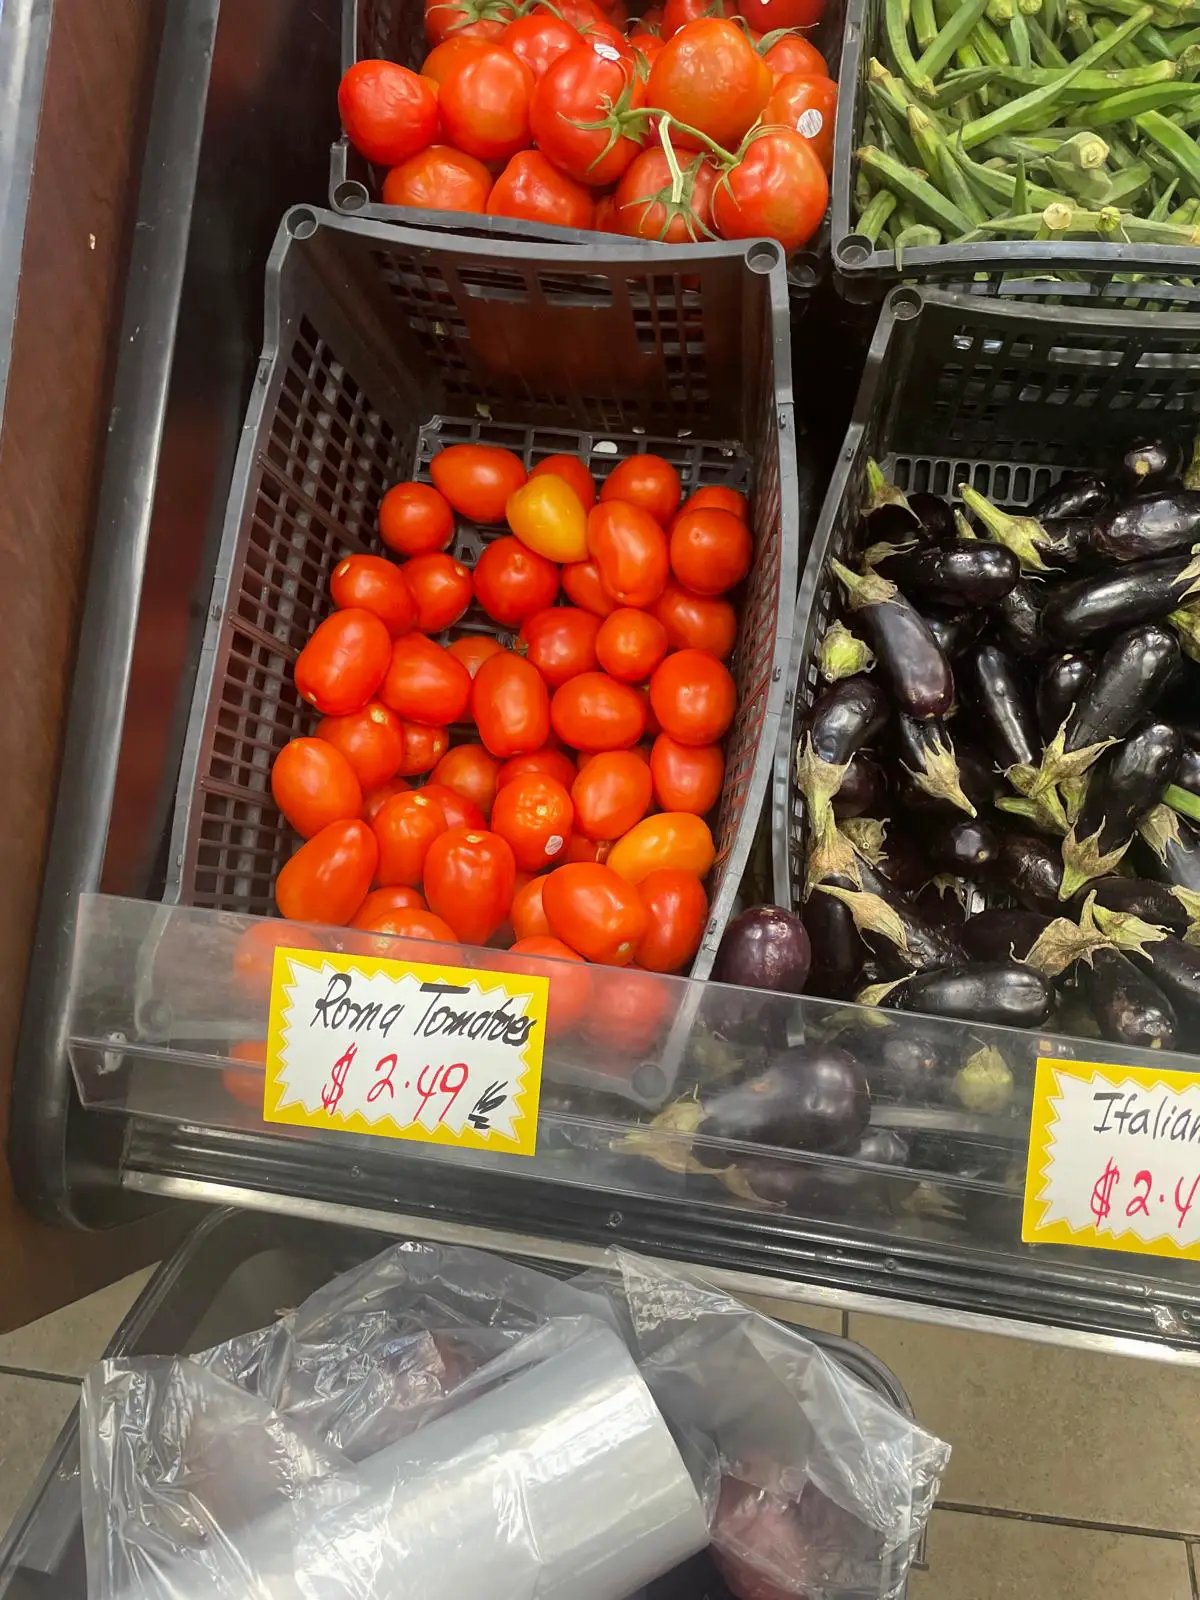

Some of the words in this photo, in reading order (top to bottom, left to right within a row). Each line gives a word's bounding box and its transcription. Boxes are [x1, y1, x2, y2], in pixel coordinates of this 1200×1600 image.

[310, 972, 405, 1038] Roma
[413, 982, 538, 1047] Tomatoes
[1093, 1092, 1200, 1144] Italian
